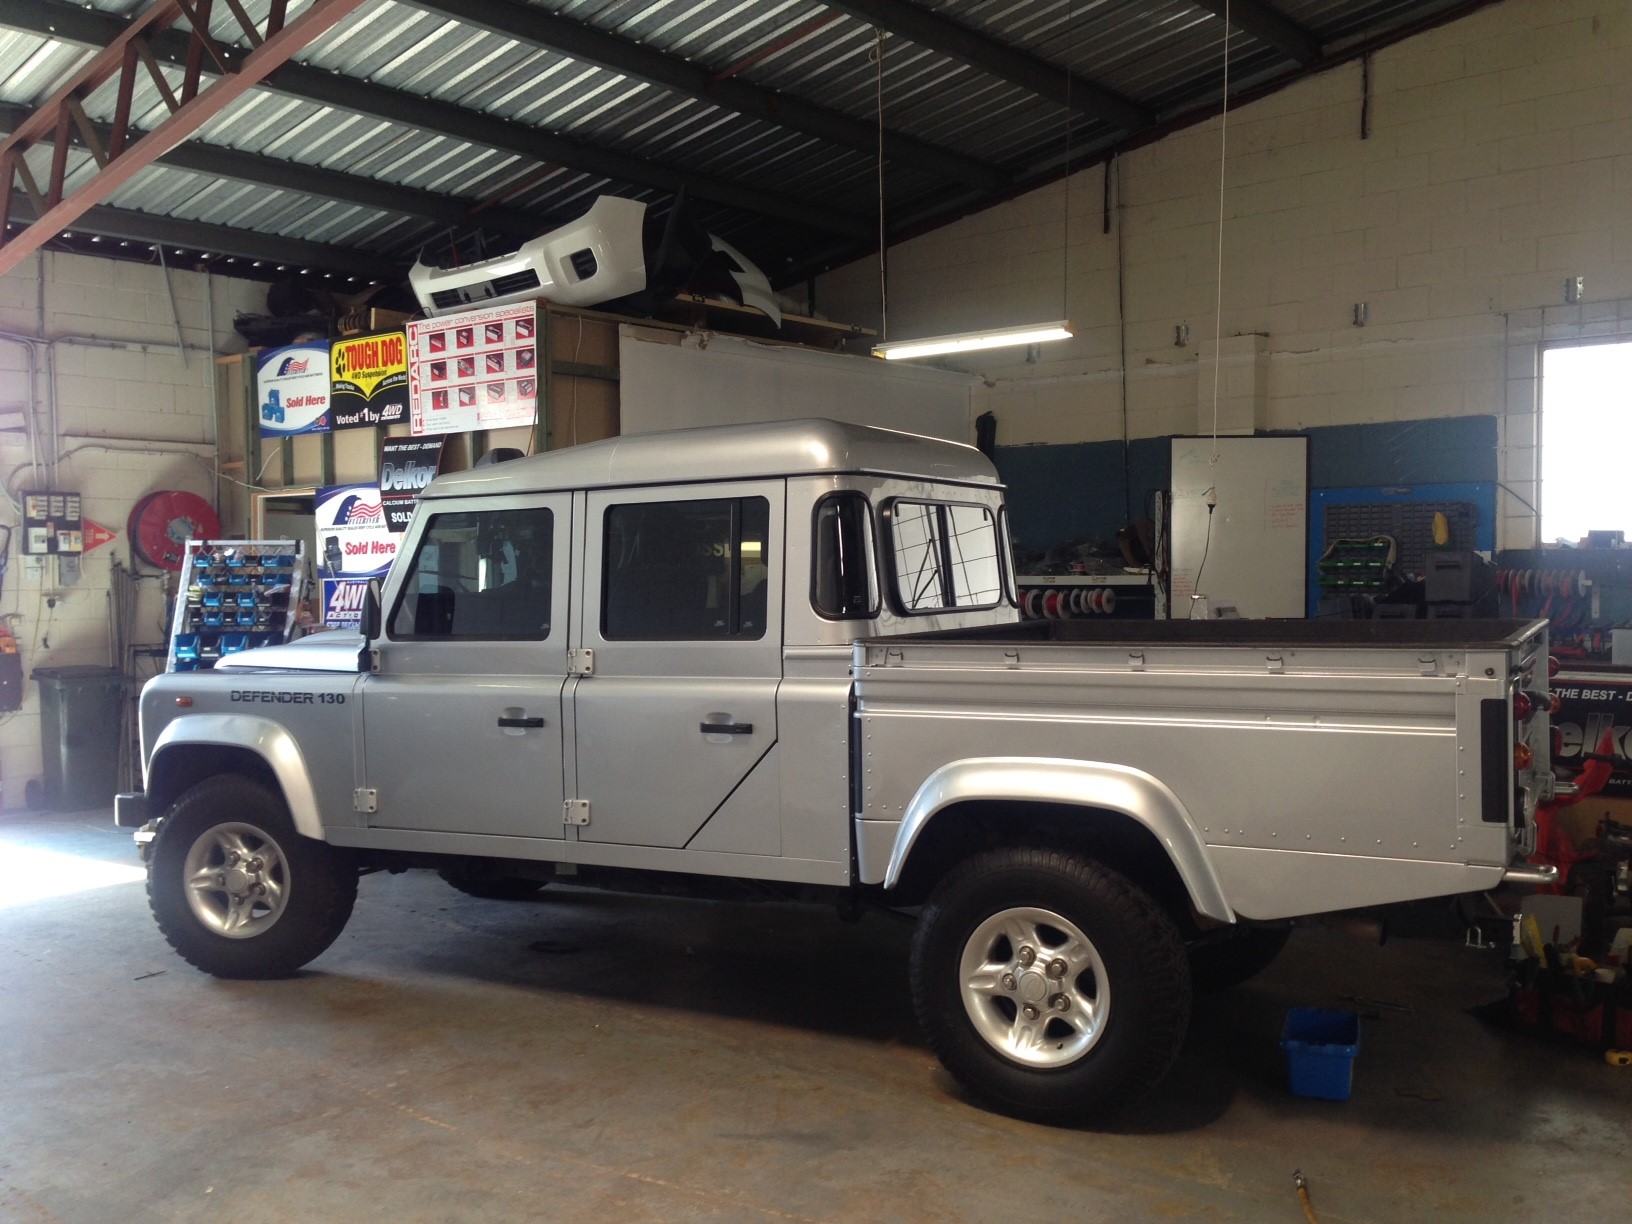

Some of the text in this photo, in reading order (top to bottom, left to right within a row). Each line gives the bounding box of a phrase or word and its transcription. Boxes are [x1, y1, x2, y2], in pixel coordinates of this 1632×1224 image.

[420, 305, 535, 330] The power conversion specialists
[345, 336, 403, 372] TOUGH DOG
[408, 324, 423, 434] REDARC
[286, 395, 326, 408] Sold Here
[336, 413, 359, 425] Voted
[369, 411, 380, 424] by
[381, 404, 403, 420] 4WD
[381, 461, 437, 490] Delkor
[391, 511, 413, 523] SOLD
[345, 541, 396, 555] Sold Here
[231, 690, 345, 704] DEFENDER 130
[1555, 688, 1579, 699] THE
[1582, 689, 1616, 700] BEST
